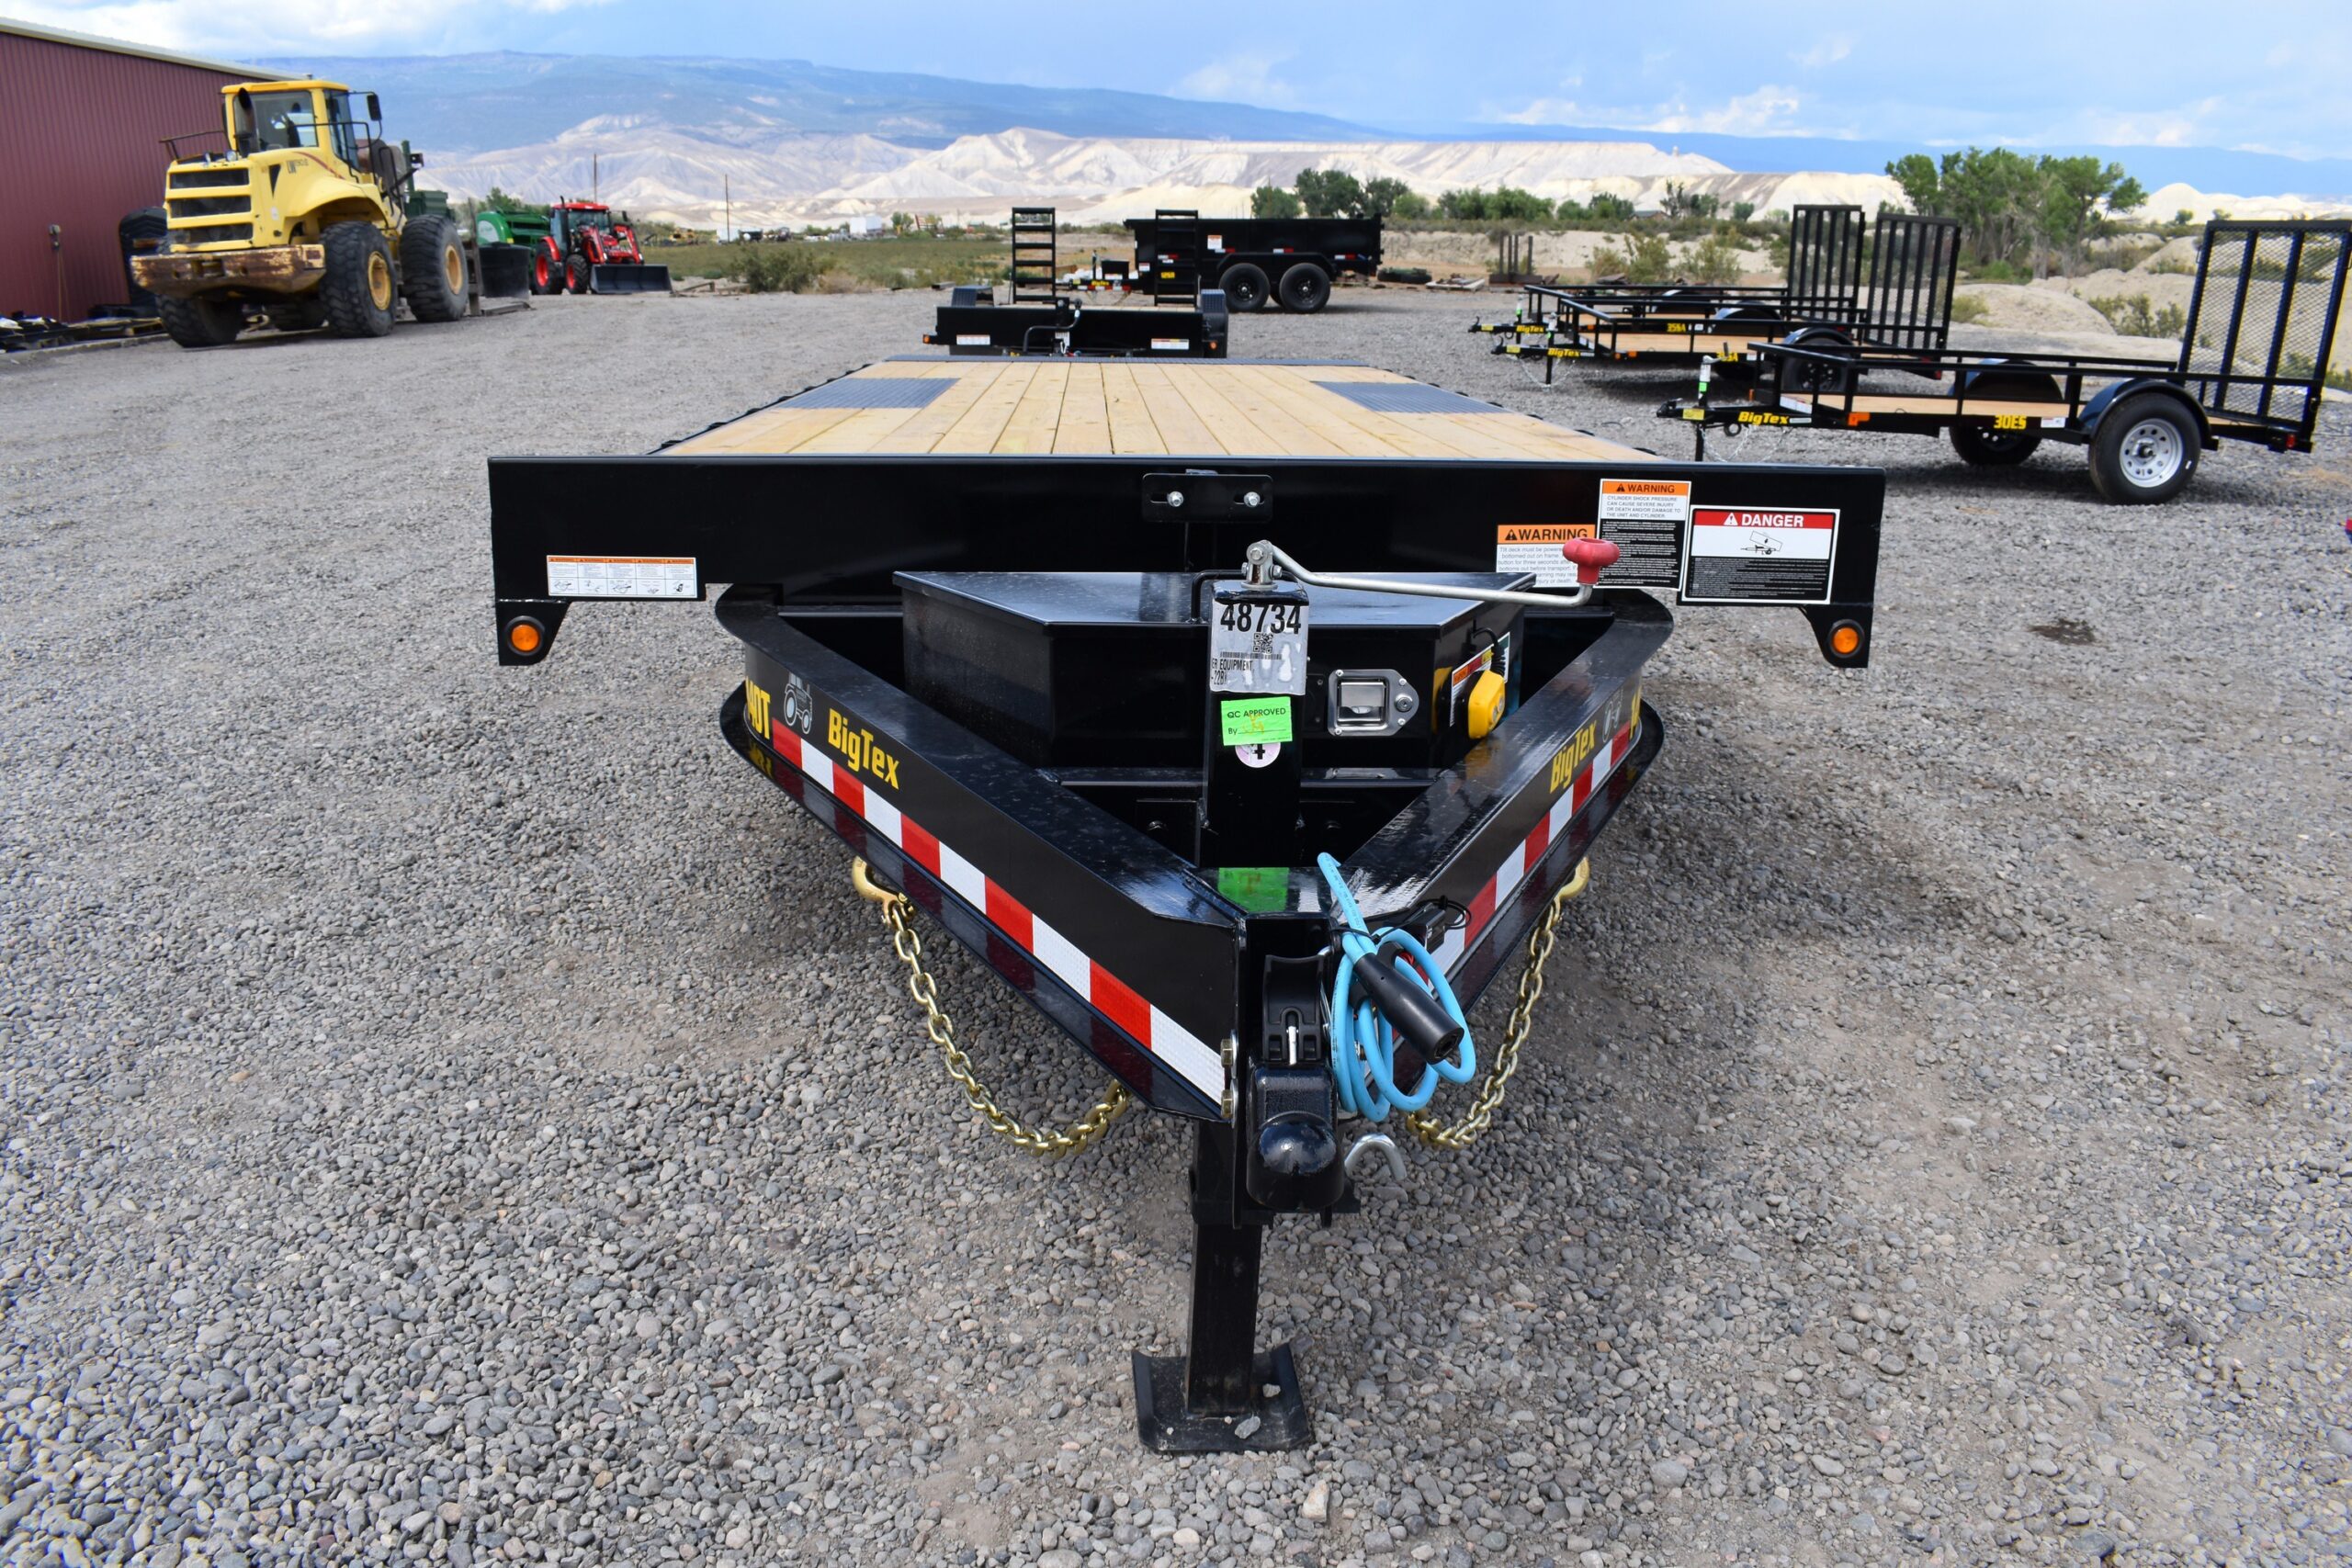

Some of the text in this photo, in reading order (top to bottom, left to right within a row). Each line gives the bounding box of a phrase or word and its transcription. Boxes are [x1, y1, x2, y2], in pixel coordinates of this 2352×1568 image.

[1547, 347, 1579, 357] BigTex
[1738, 412, 1790, 425] BigTex
[1994, 415, 2027, 429] 30ES
[1627, 484, 1675, 493] WARNING
[1741, 514, 1804, 527] DANGER
[1519, 528, 1588, 540] WARNING
[1220, 603, 1301, 635] 48734
[1227, 707, 1286, 719] QC APPROVED
[1227, 728, 1238, 736] By
[828, 707, 900, 791] BigTex
[1549, 719, 1598, 795] BigTex
